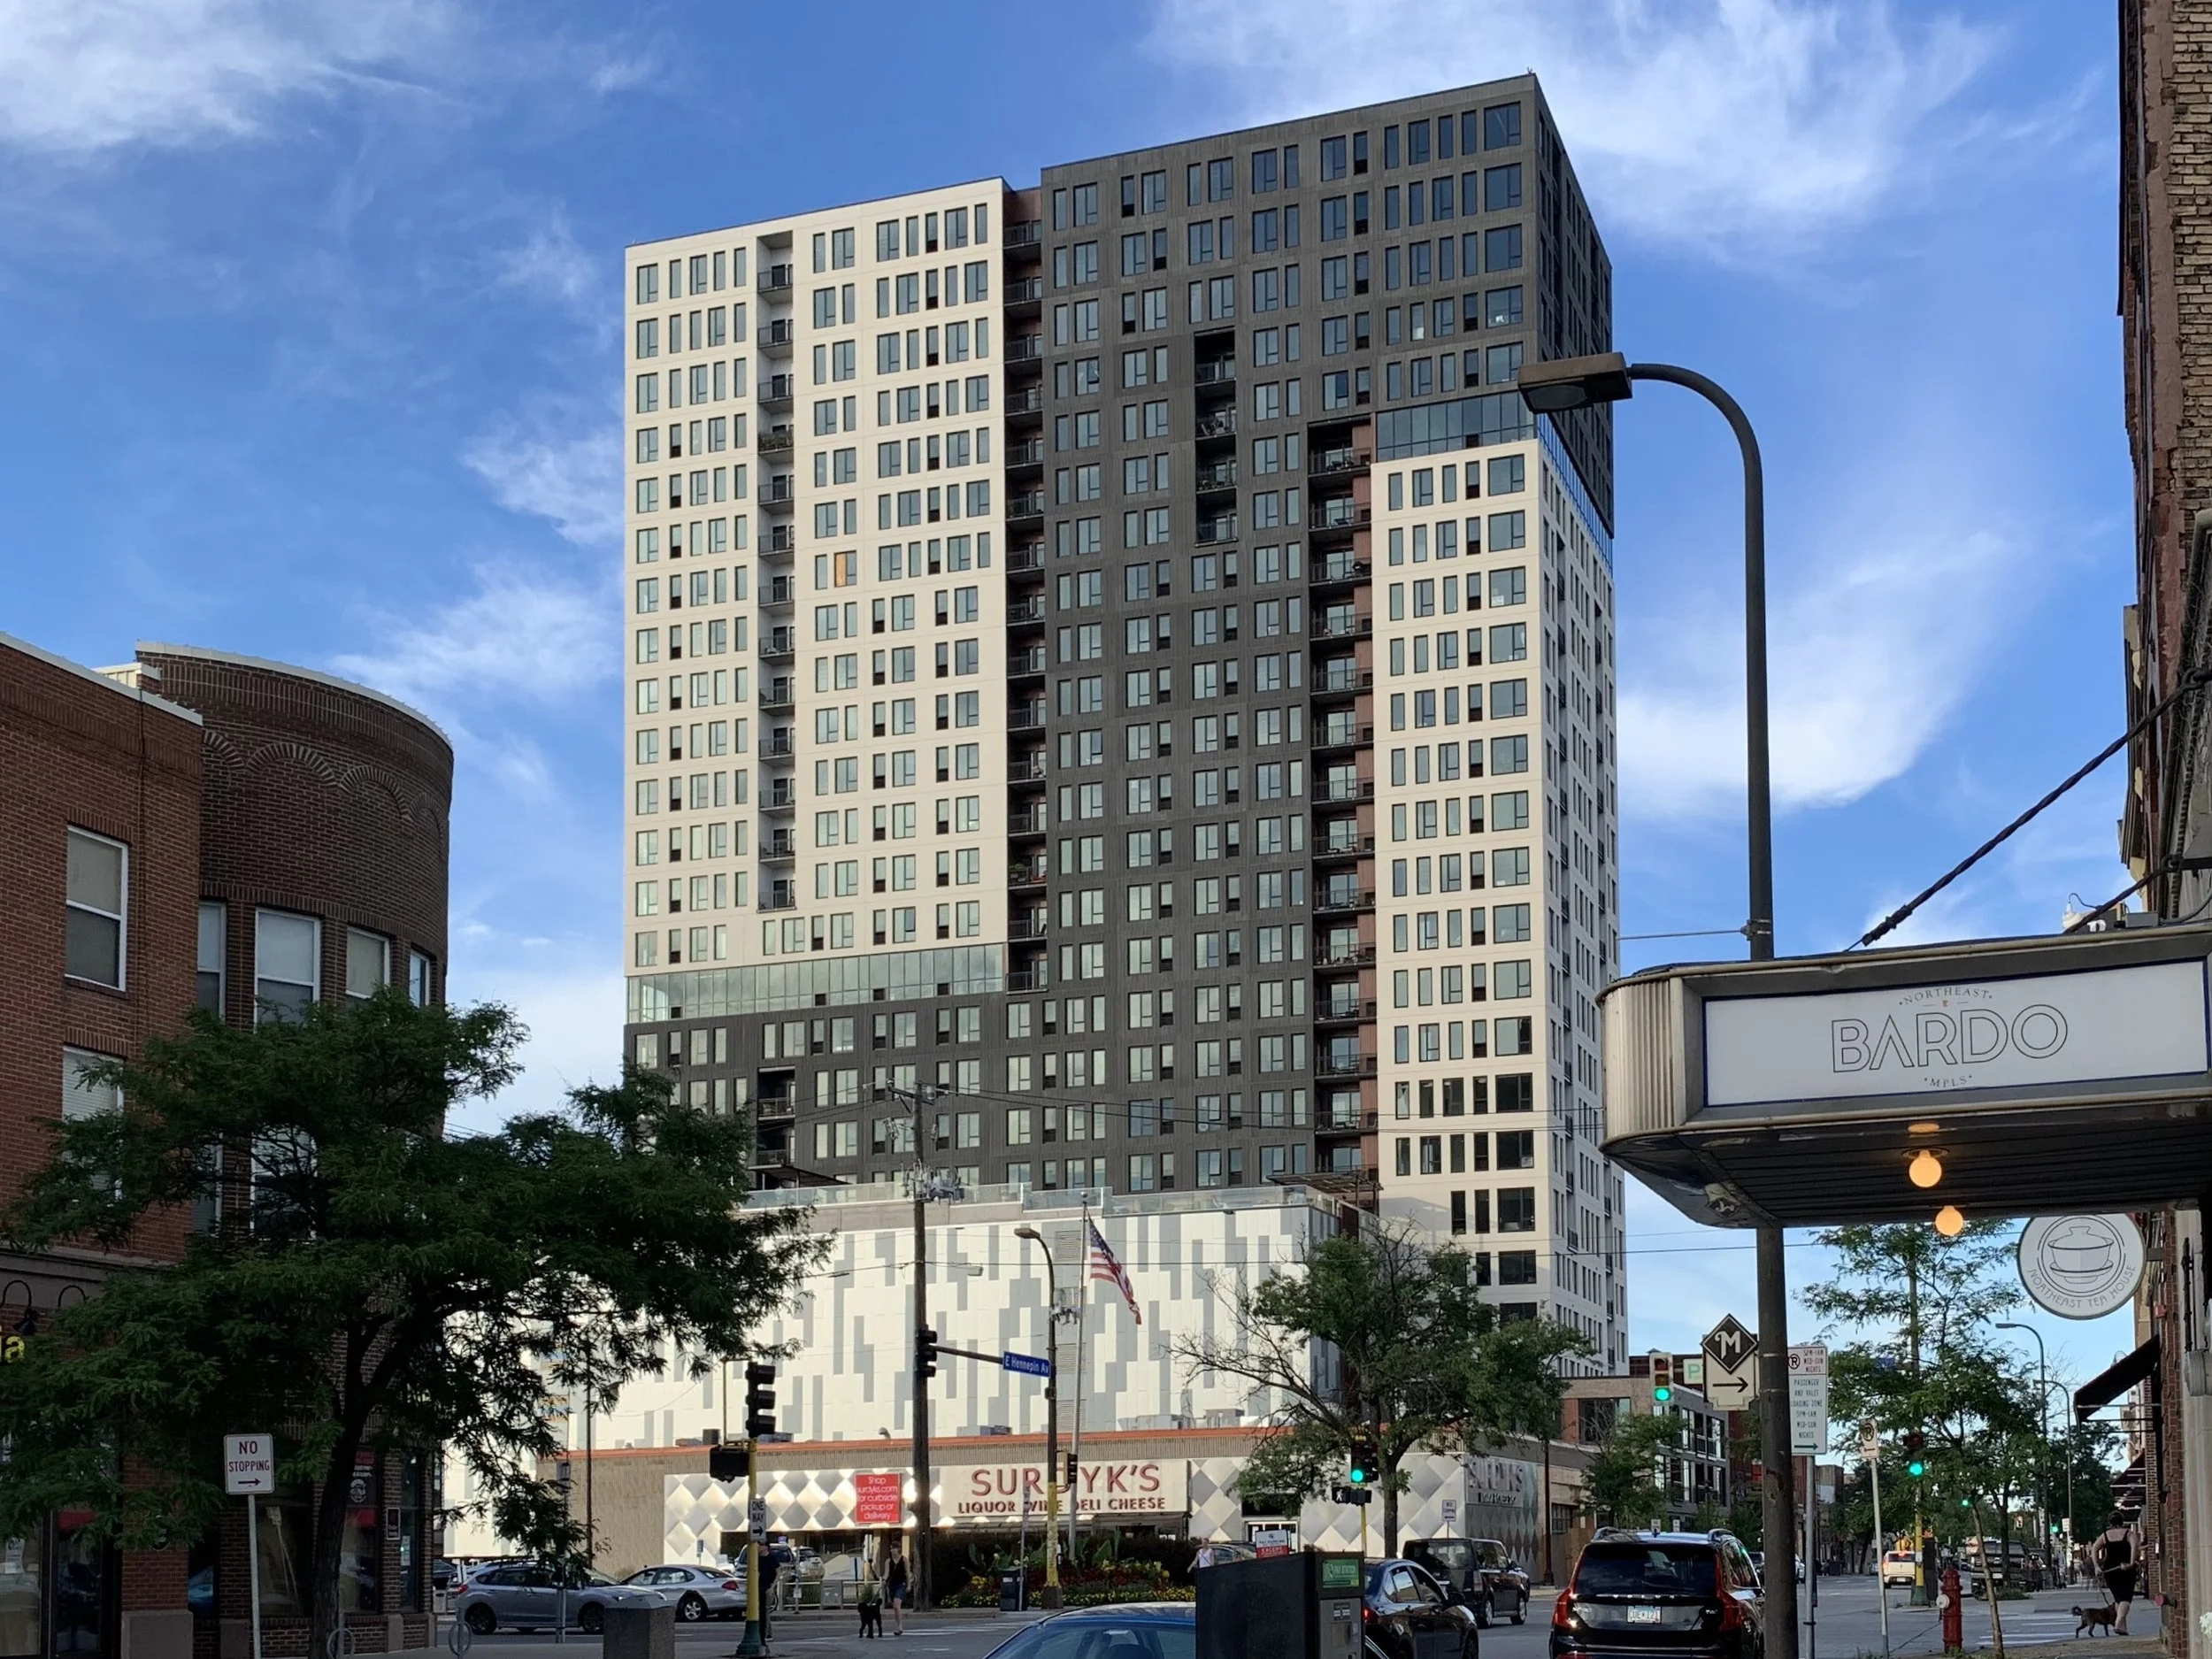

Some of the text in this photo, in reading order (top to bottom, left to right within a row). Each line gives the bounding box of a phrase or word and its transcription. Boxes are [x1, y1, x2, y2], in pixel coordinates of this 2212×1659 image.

[1904, 987, 1991, 1004] NORTHEAST
[1832, 1003, 2069, 1073] BARDO
[1931, 1075, 1968, 1088] MPLS
[2027, 1264, 2136, 1309] NORTHEAST TEA HOUSE
[1005, 1356, 1010, 1367] E
[1011, 1356, 1040, 1373] Hennepin
[238, 1440, 258, 1455] NO
[228, 1460, 270, 1473] STOPPING
[868, 1476, 887, 1486] Shop
[752, 1500, 764, 1511] ONE
[860, 1502, 886, 1512] pickup
[958, 1501, 1016, 1514] LIQUOR
[1108, 1497, 1166, 1509] CHEESE
[752, 1513, 764, 1523] WAY
